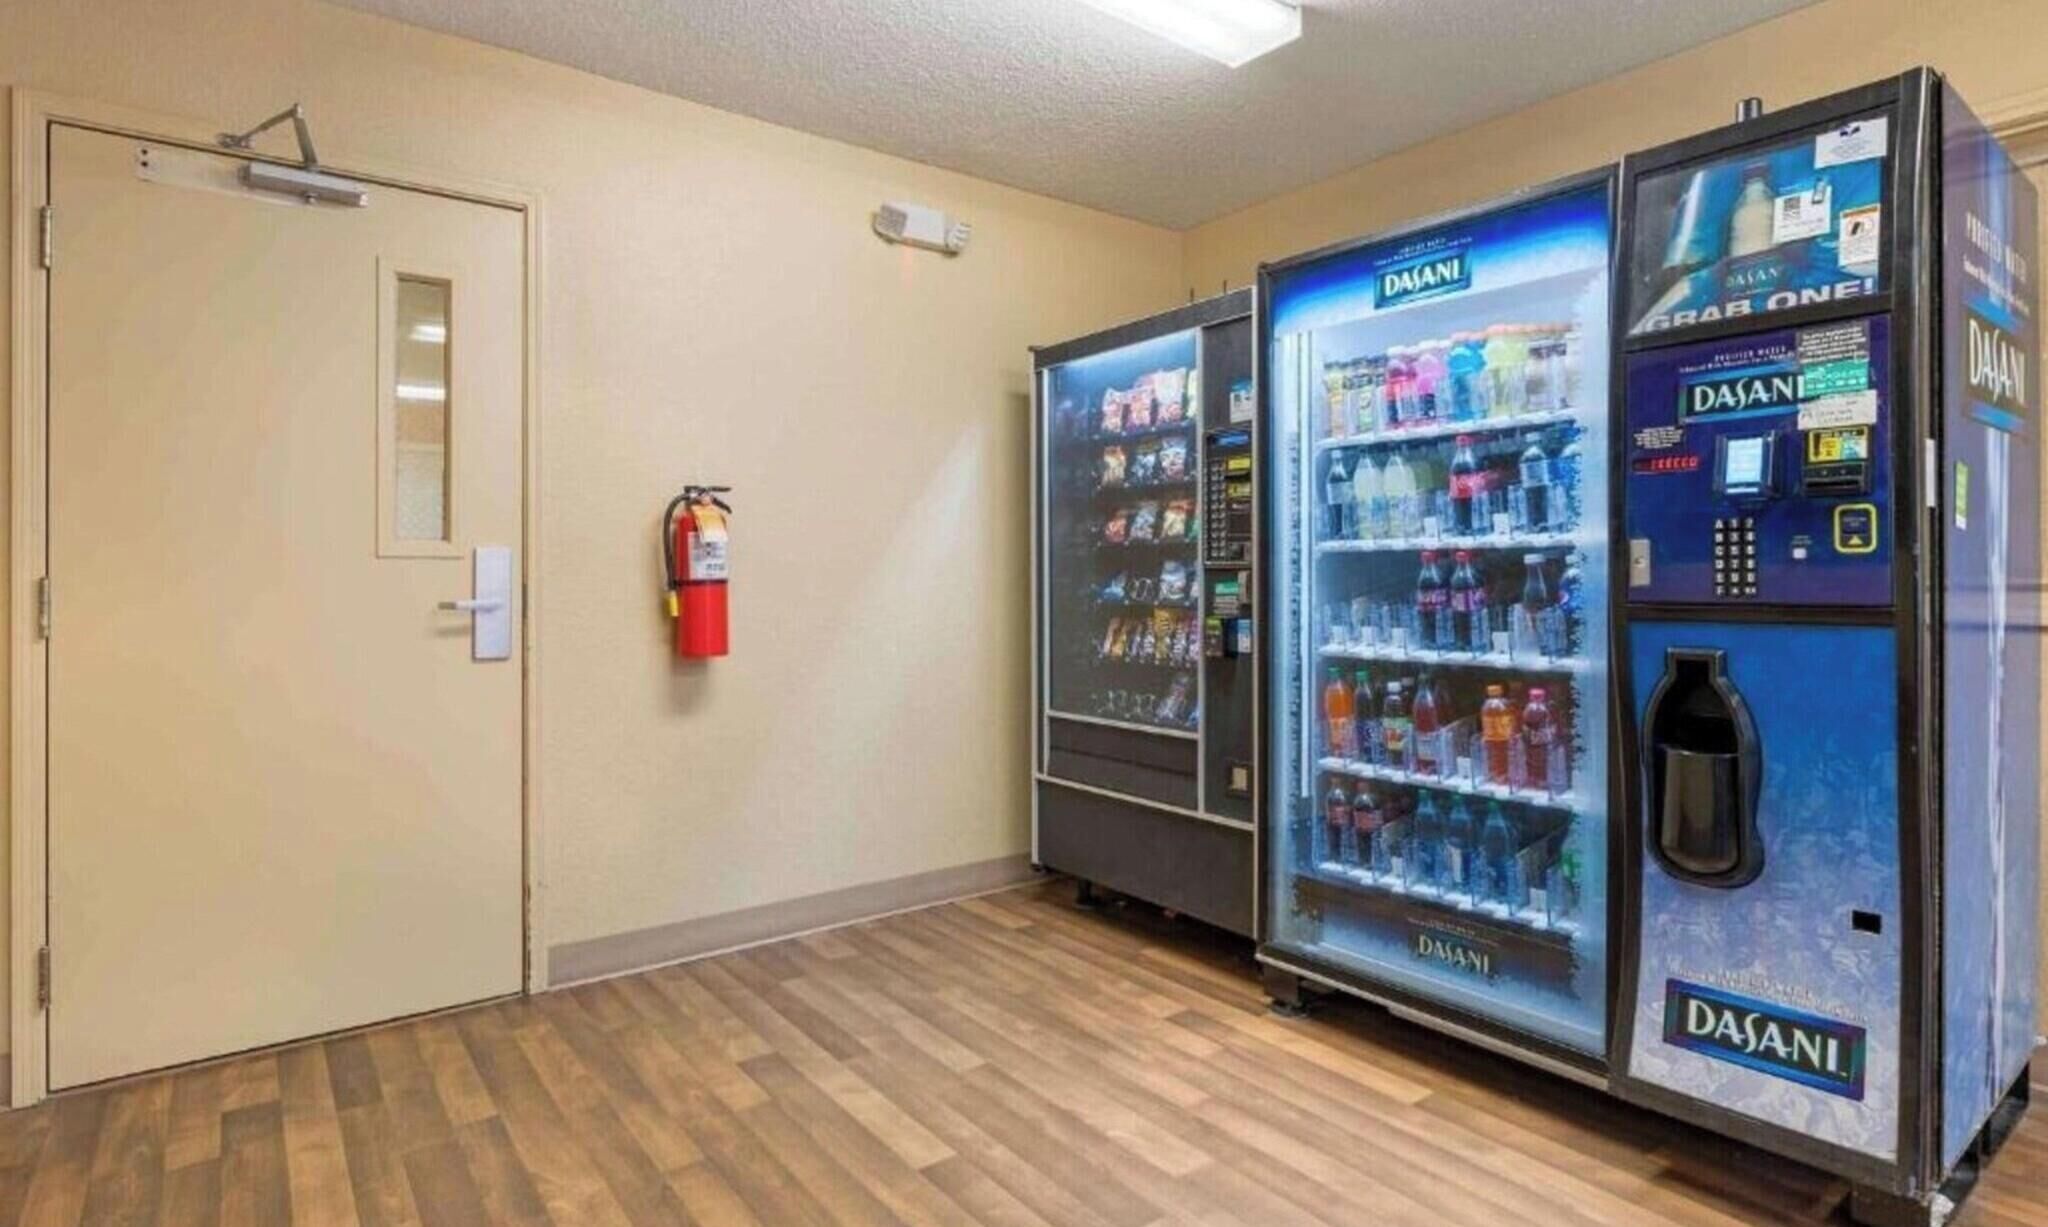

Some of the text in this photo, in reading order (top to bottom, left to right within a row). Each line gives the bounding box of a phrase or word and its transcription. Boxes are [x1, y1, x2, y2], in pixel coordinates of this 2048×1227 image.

[1384, 258, 1460, 297] DASANI
[1726, 265, 1784, 288] DASAN
[1644, 277, 1873, 332] GRAB ONE!
[1968, 317, 2025, 404] DASANI
[1694, 375, 1804, 413] DASANI
[1419, 934, 1489, 974] DASANI
[1687, 999, 1838, 1072] DASANI
